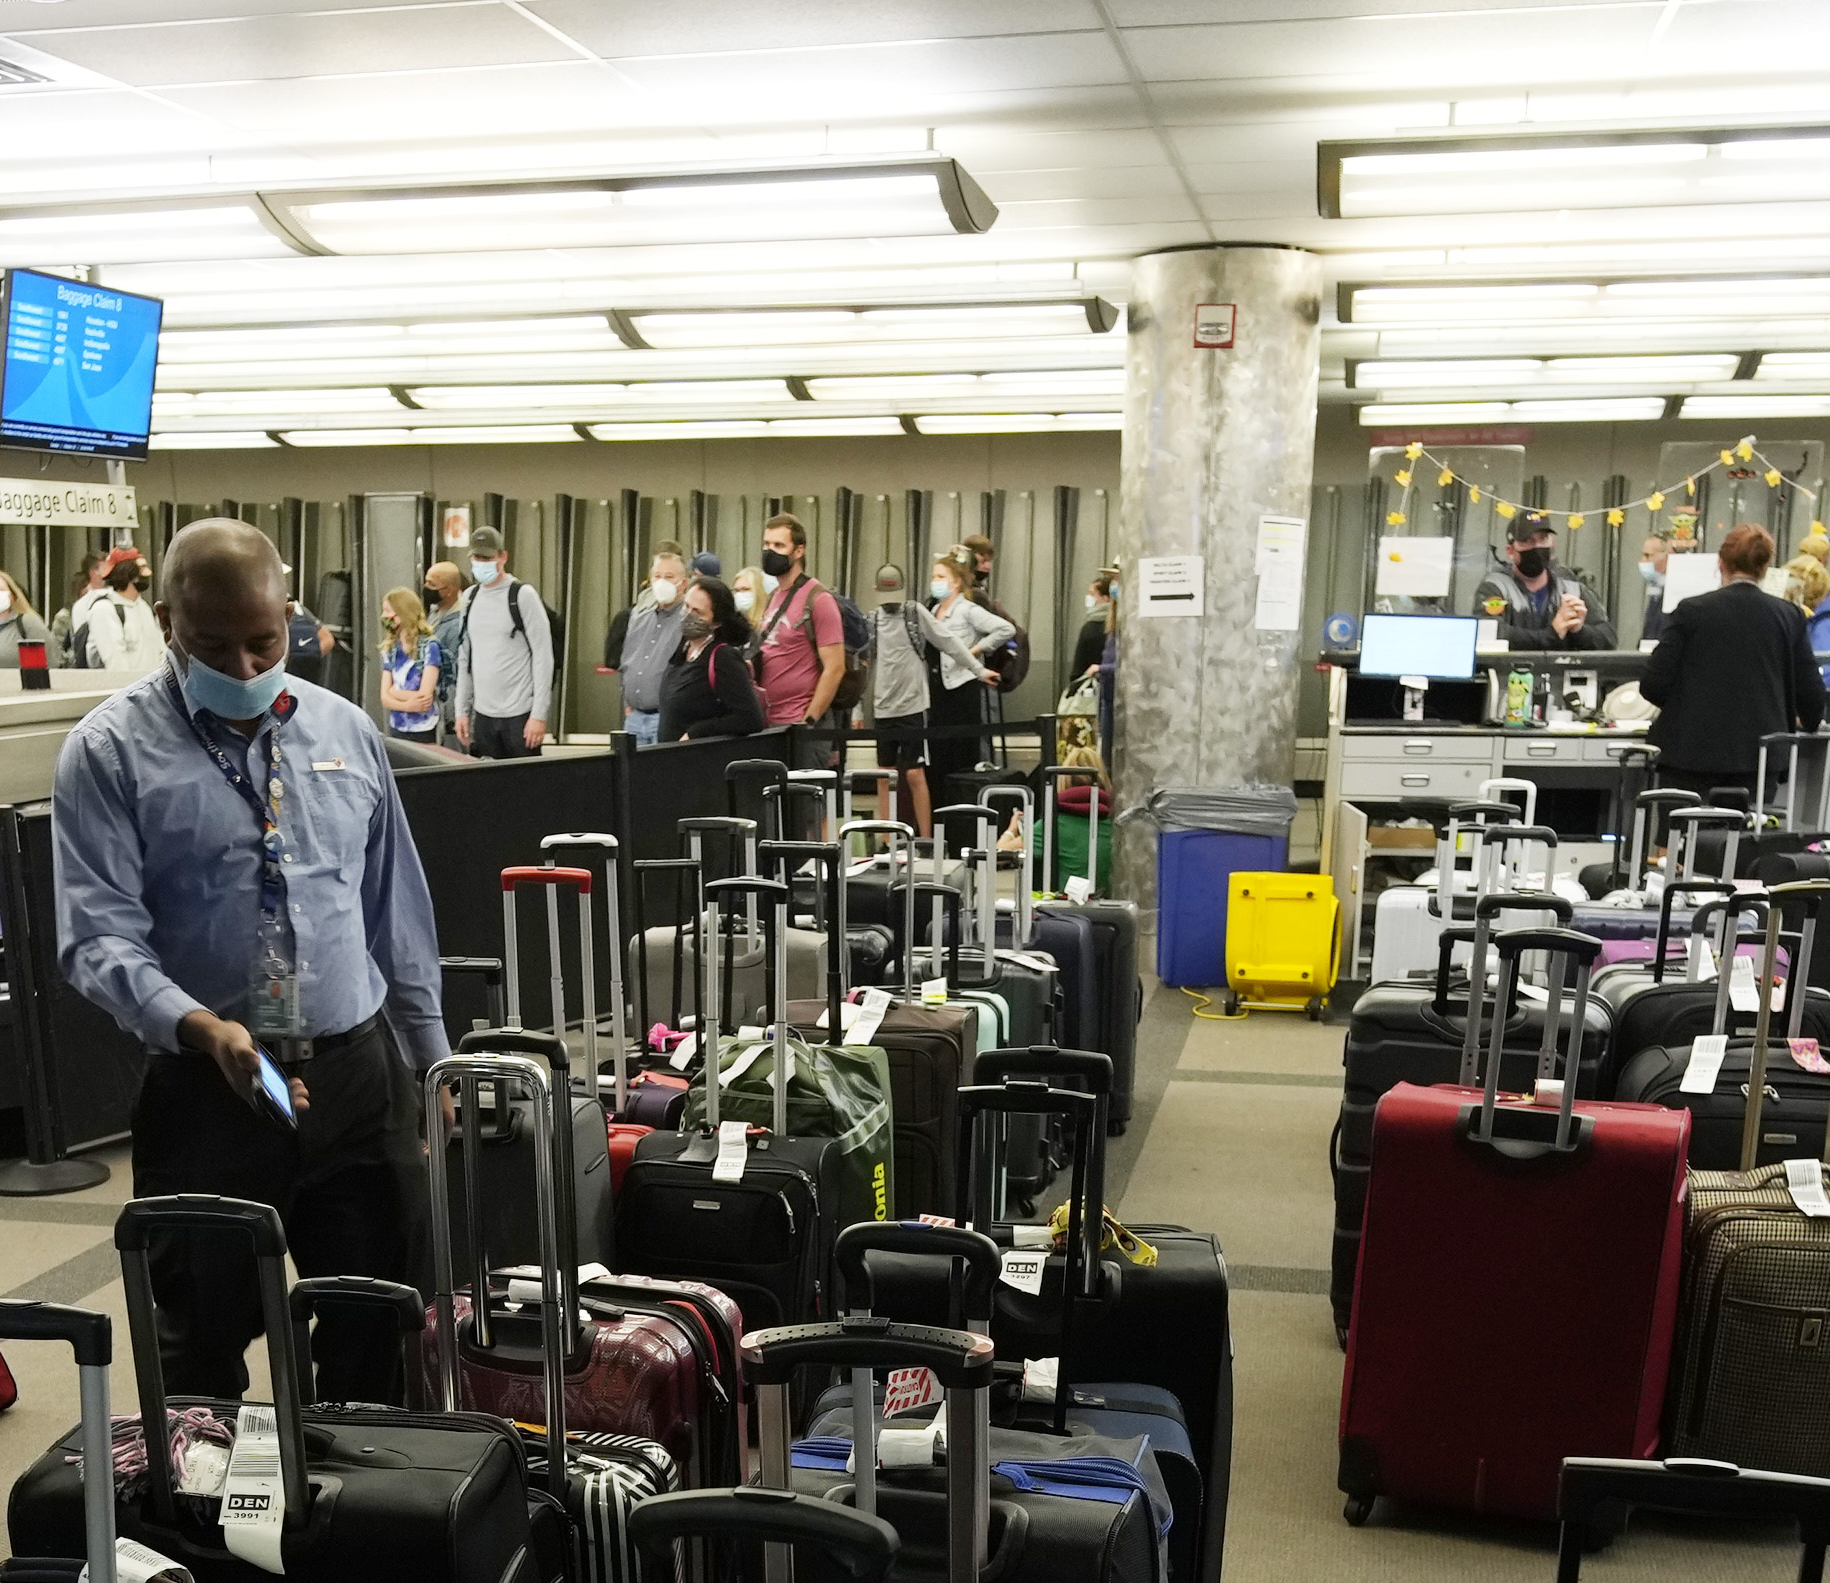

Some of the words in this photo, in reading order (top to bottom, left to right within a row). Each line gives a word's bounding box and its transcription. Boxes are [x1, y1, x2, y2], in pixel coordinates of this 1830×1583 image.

[57, 284, 93, 309] Baggage
[93, 292, 116, 311] Claim
[115, 298, 123, 312] 8
[64, 490, 105, 515] Claim
[107, 493, 117, 515] 8
[1006, 1262, 1038, 1274] DEN
[229, 1496, 270, 1510] DEN
